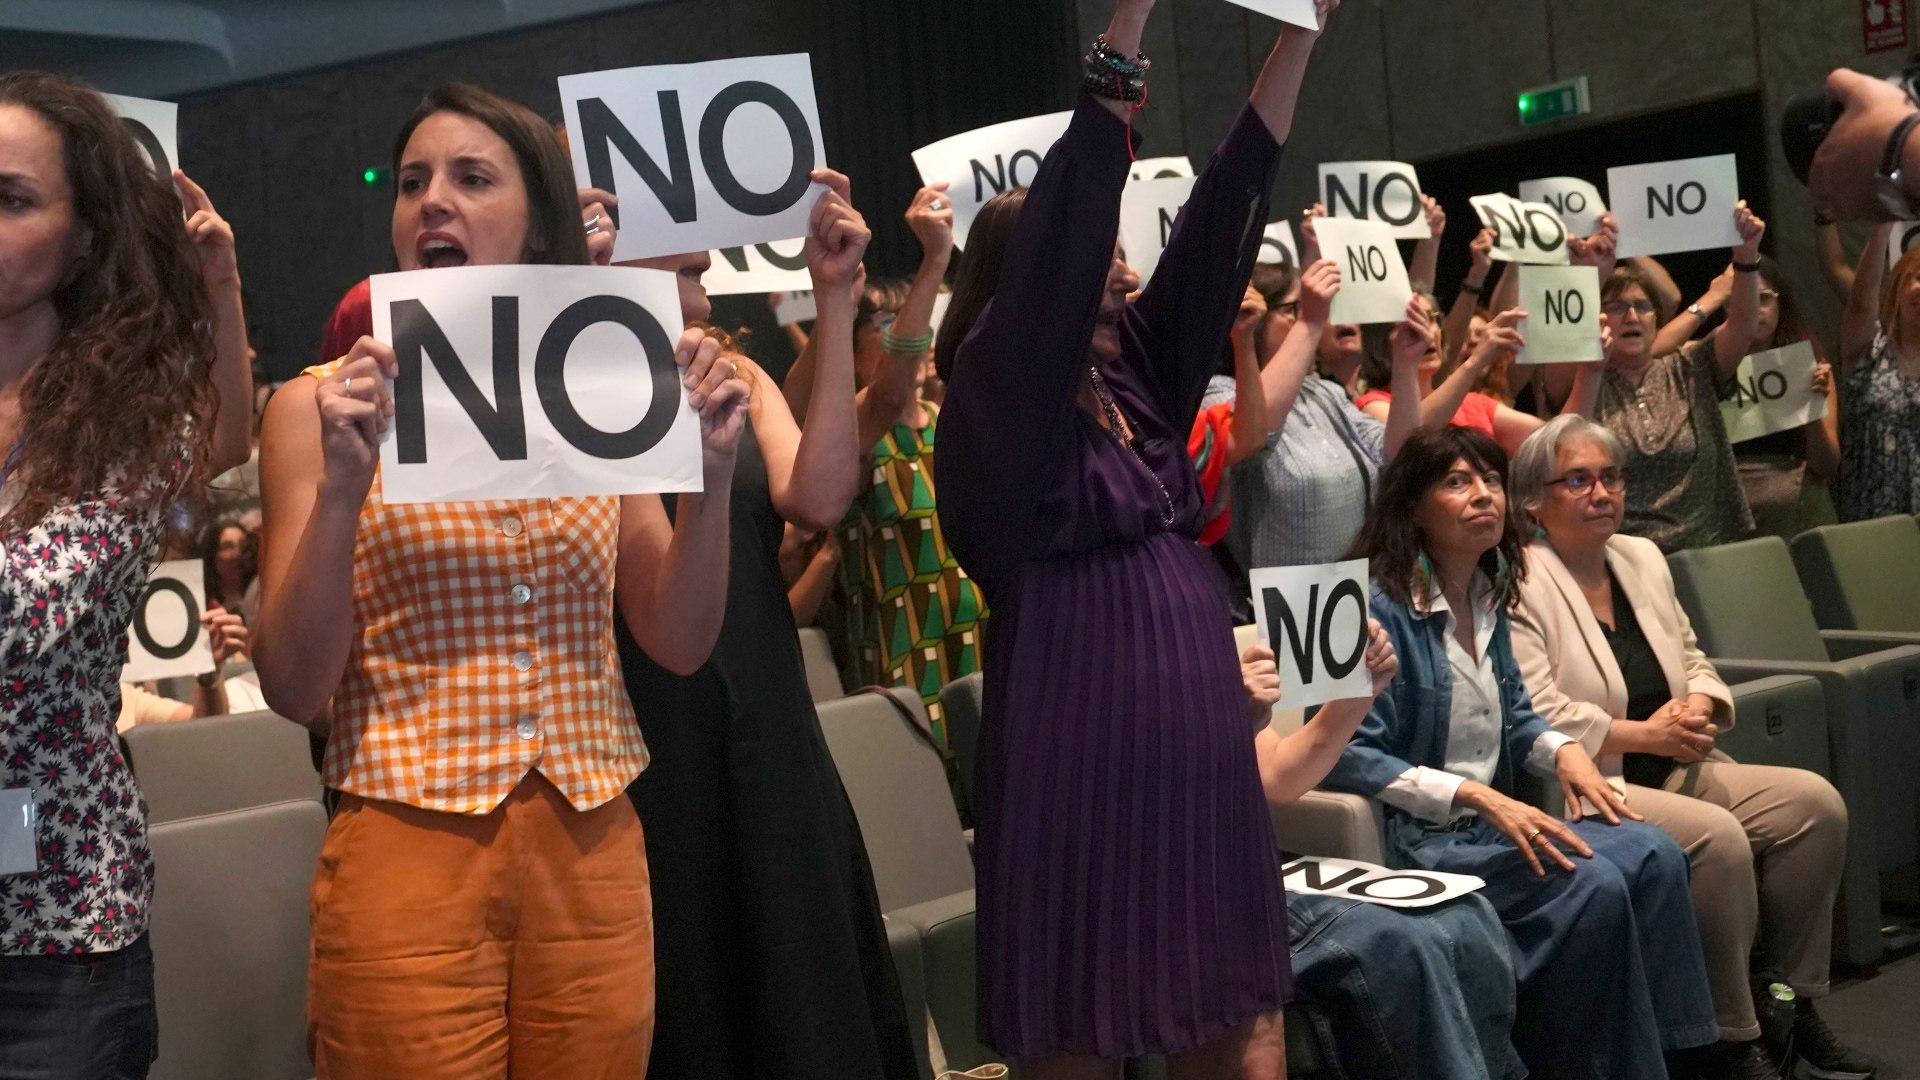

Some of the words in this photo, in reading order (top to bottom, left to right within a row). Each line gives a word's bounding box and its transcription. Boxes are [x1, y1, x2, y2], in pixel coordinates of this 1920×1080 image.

[576, 80, 815, 230] NO
[1326, 172, 1421, 227] NO
[1543, 191, 1586, 215] NO
[1646, 181, 1707, 219] NO
[1480, 203, 1564, 252] NO
[1346, 245, 1387, 281] NO
[1545, 289, 1584, 325] NO
[389, 294, 682, 465] NO
[1736, 370, 1787, 408] NO
[123, 577, 201, 663] O
[1262, 578, 1368, 685] NO
[1282, 860, 1447, 900] NO
